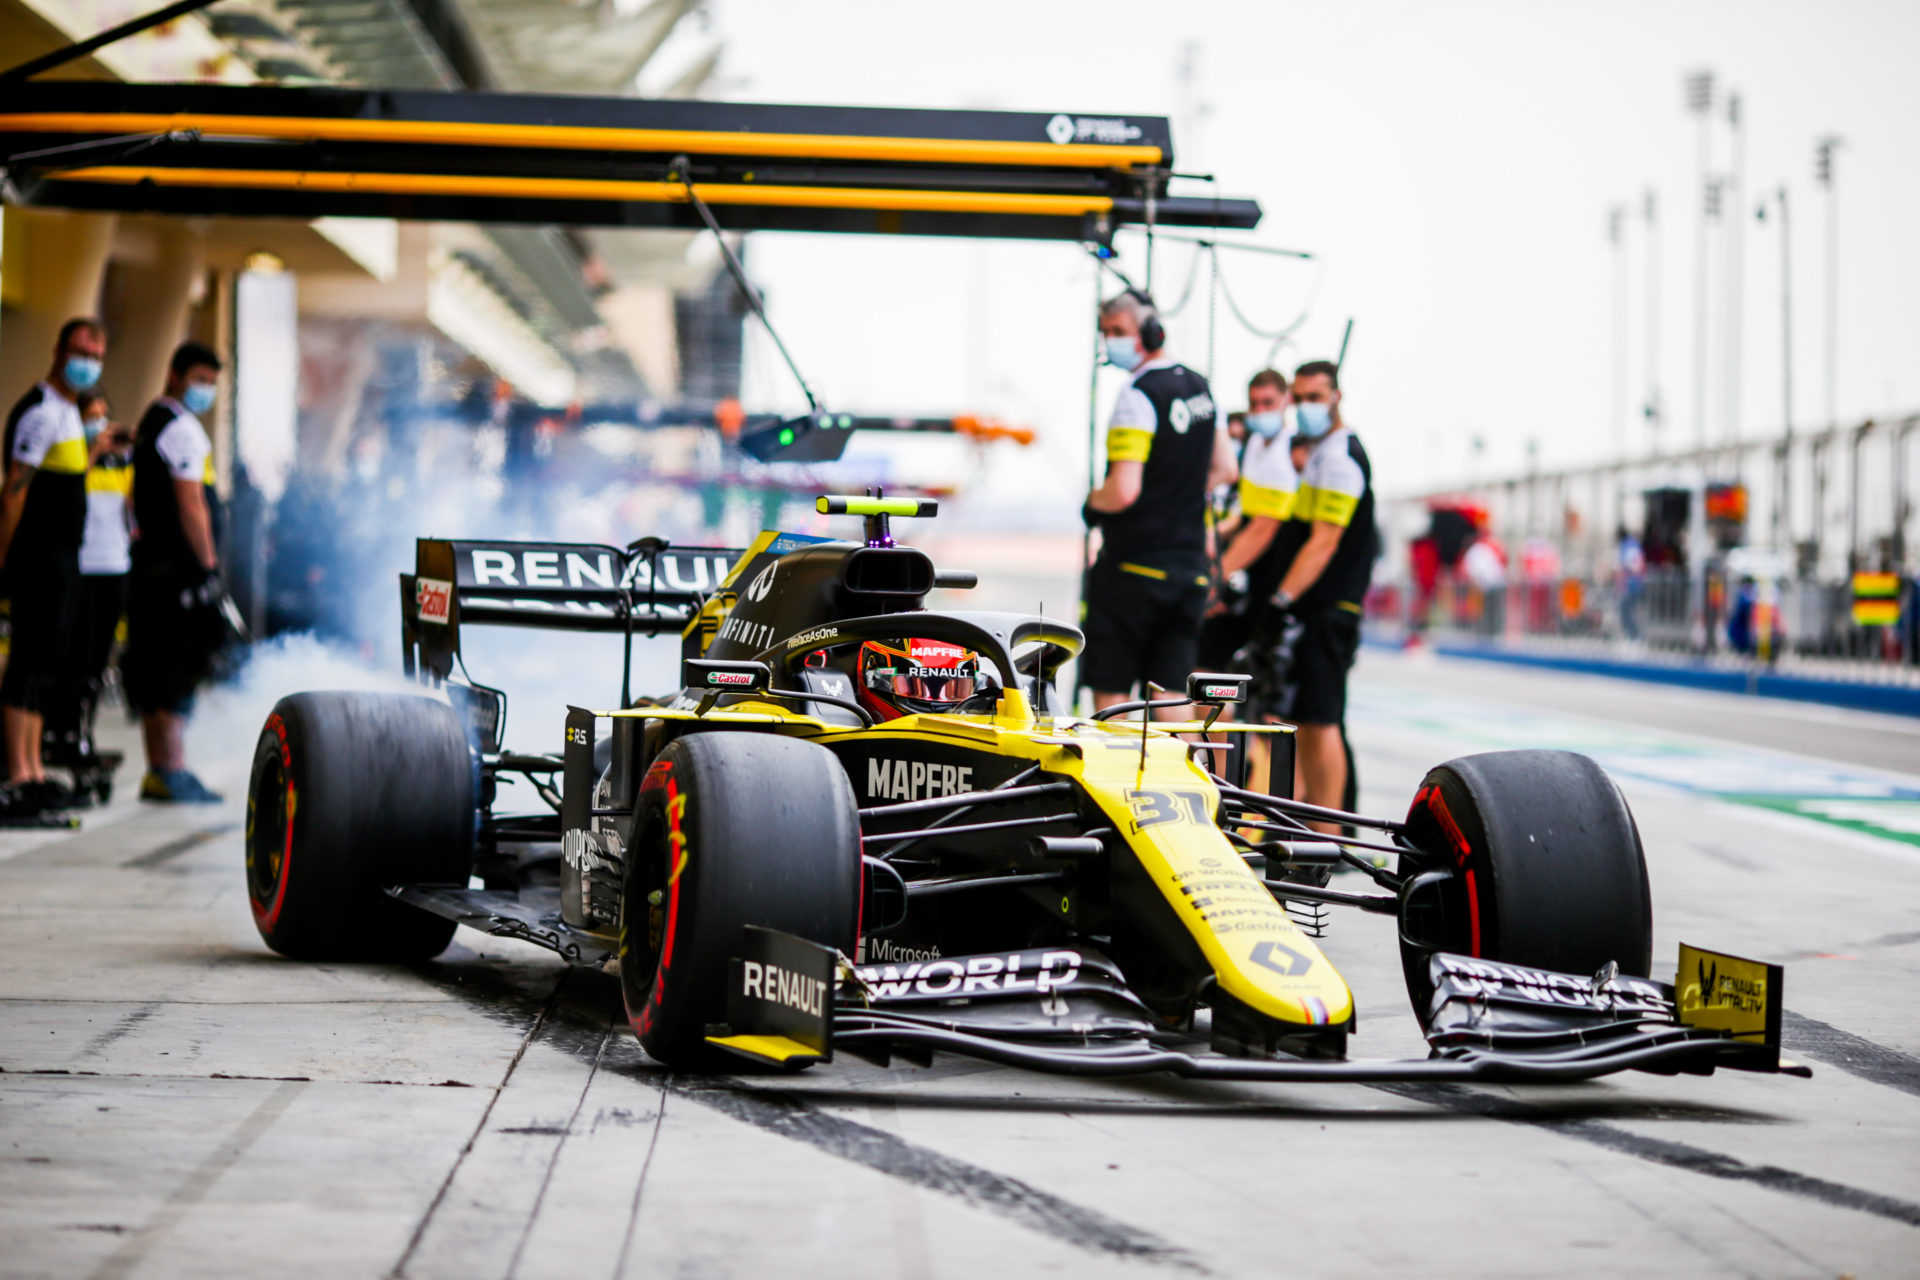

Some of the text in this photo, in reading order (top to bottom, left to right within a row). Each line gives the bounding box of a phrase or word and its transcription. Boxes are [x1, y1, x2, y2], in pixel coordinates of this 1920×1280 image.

[911, 647, 964, 659] MAPFRE
[717, 673, 751, 684] Castrol
[908, 666, 969, 678] RENAULT
[1214, 686, 1238, 697] Castrol
[867, 757, 973, 801] MAPFRE
[1124, 789, 1210, 833] 31
[872, 937, 942, 963] Microsoft
[857, 950, 1083, 997] WORLD
[1718, 974, 1763, 997] RENAULT
[743, 960, 828, 1019] RENAULT
[1717, 991, 1763, 1015] VITALITY
